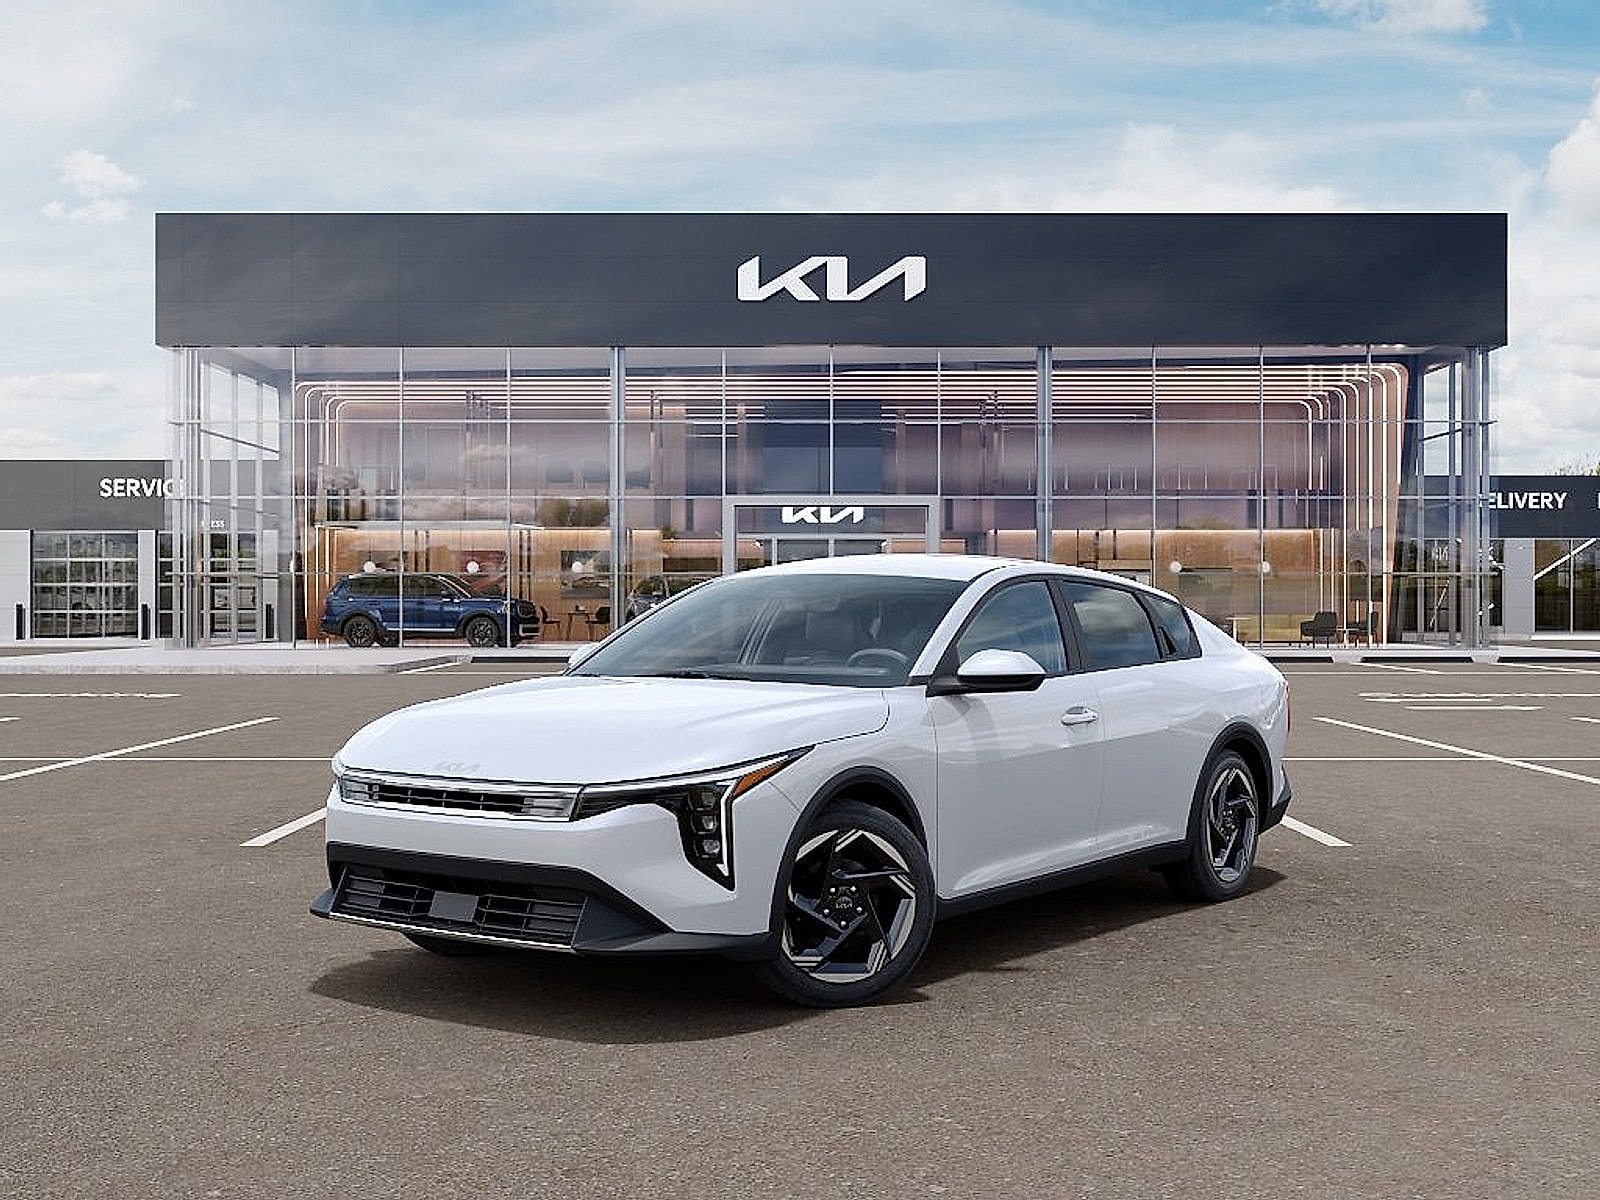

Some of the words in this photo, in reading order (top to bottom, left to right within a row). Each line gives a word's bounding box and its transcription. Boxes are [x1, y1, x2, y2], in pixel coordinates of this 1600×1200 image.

[737, 255, 926, 301] KIA
[1478, 492, 1567, 509] ELIVERY
[781, 506, 864, 524] KIA
